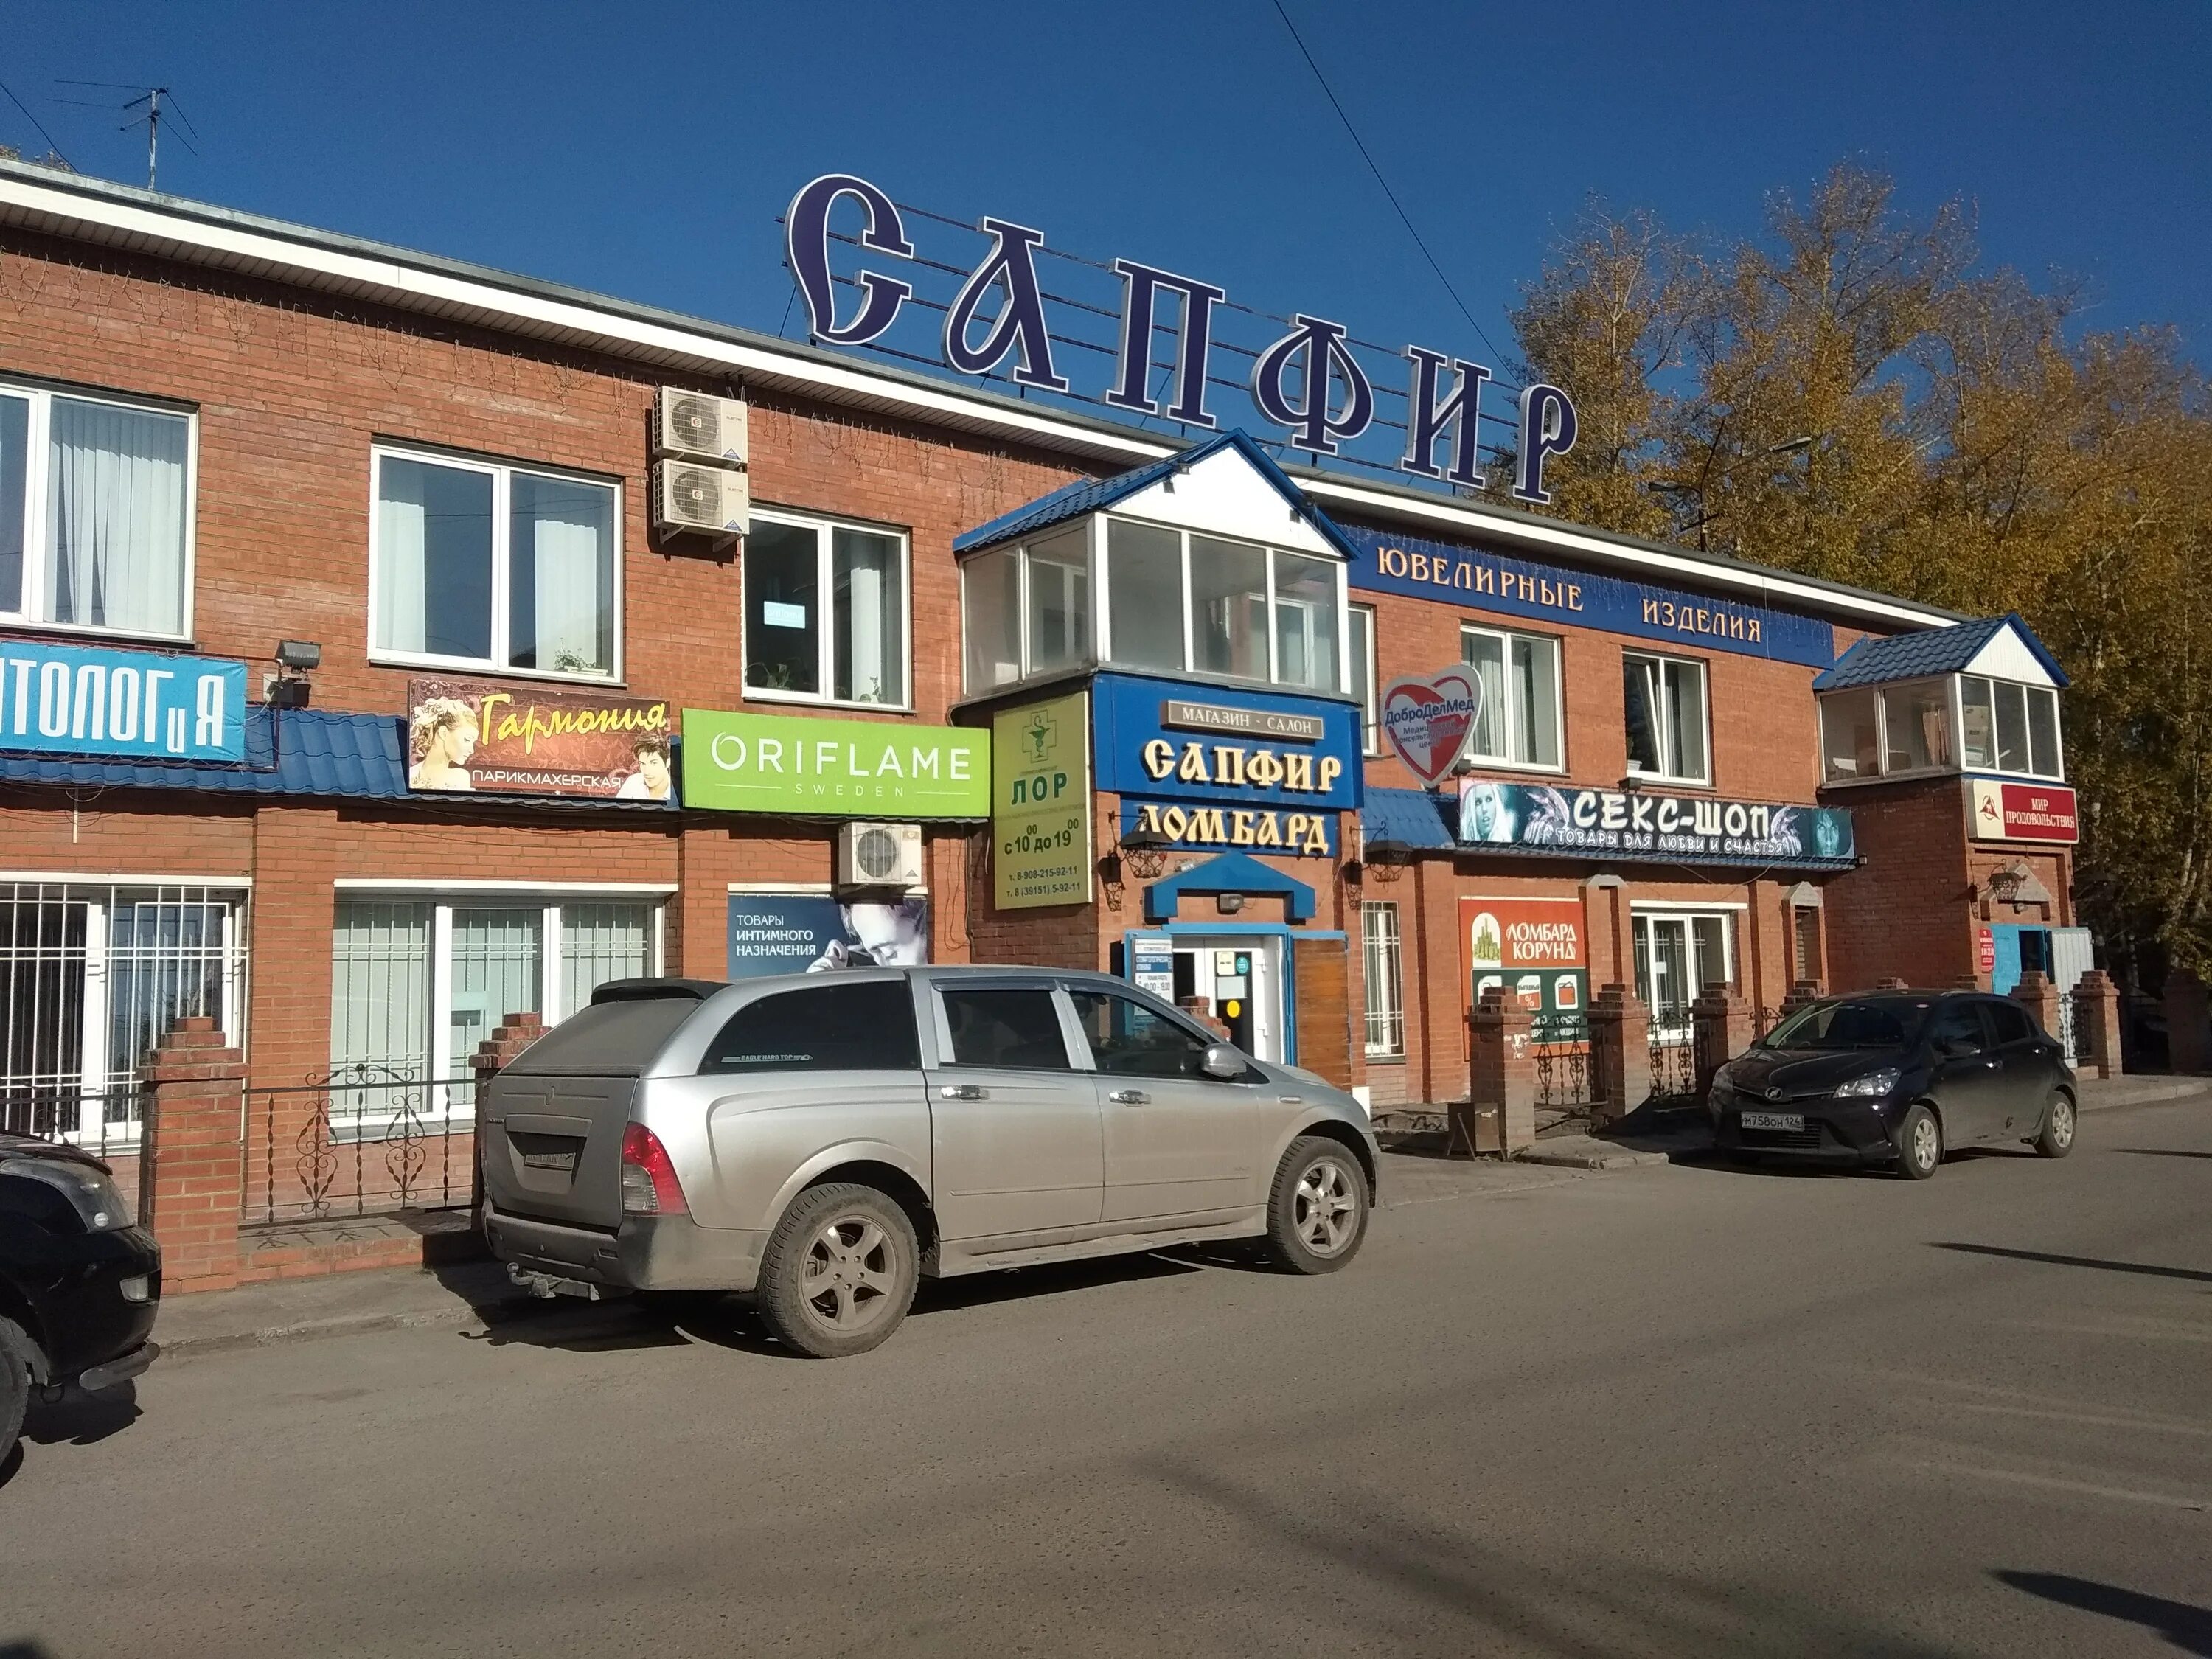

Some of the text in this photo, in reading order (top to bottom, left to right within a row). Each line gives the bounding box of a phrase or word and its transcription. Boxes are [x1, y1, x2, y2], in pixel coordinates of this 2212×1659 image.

[783, 173, 1578, 505] САПФИР
[1377, 546, 1761, 643] ЮВЕЛИРНЫЕ ИЗДЕЛИЯ
[0, 657, 224, 754] ТОЛОГиЯ
[1385, 699, 1475, 727] ДоброДелМед
[480, 693, 666, 755] Гармония
[1182, 706, 1250, 727] МАГАЗИН
[1267, 717, 1312, 734] САЛОН
[711, 731, 971, 780] ORIFLAME
[1144, 740, 1342, 792] САПФИР
[472, 769, 623, 789] ПАРИКМАХЕРСКАЯ
[795, 783, 904, 797] SWEDEN
[1012, 773, 1068, 805] ЛОР
[1573, 791, 1770, 838] СЕКС-ШОП
[2031, 798, 2049, 811] МИР
[1140, 805, 1329, 855] ЛОМБАРД
[2006, 810, 2075, 829] ПРОДОВОЛЬСТВИЯ
[1034, 837, 1051, 853] до
[1555, 829, 1784, 856] ТОВАРЫ ДЛЯ ЛЮБВИ И СЧАСТЬЯ
[737, 914, 784, 927] ТОВАРЫ
[1506, 922, 1576, 942] ЛОМБАРД
[736, 930, 813, 942] ИНТИМНОГО
[736, 944, 816, 957] НАЗНАЧЕНИЯ
[1512, 941, 1576, 961] КОРУНД
